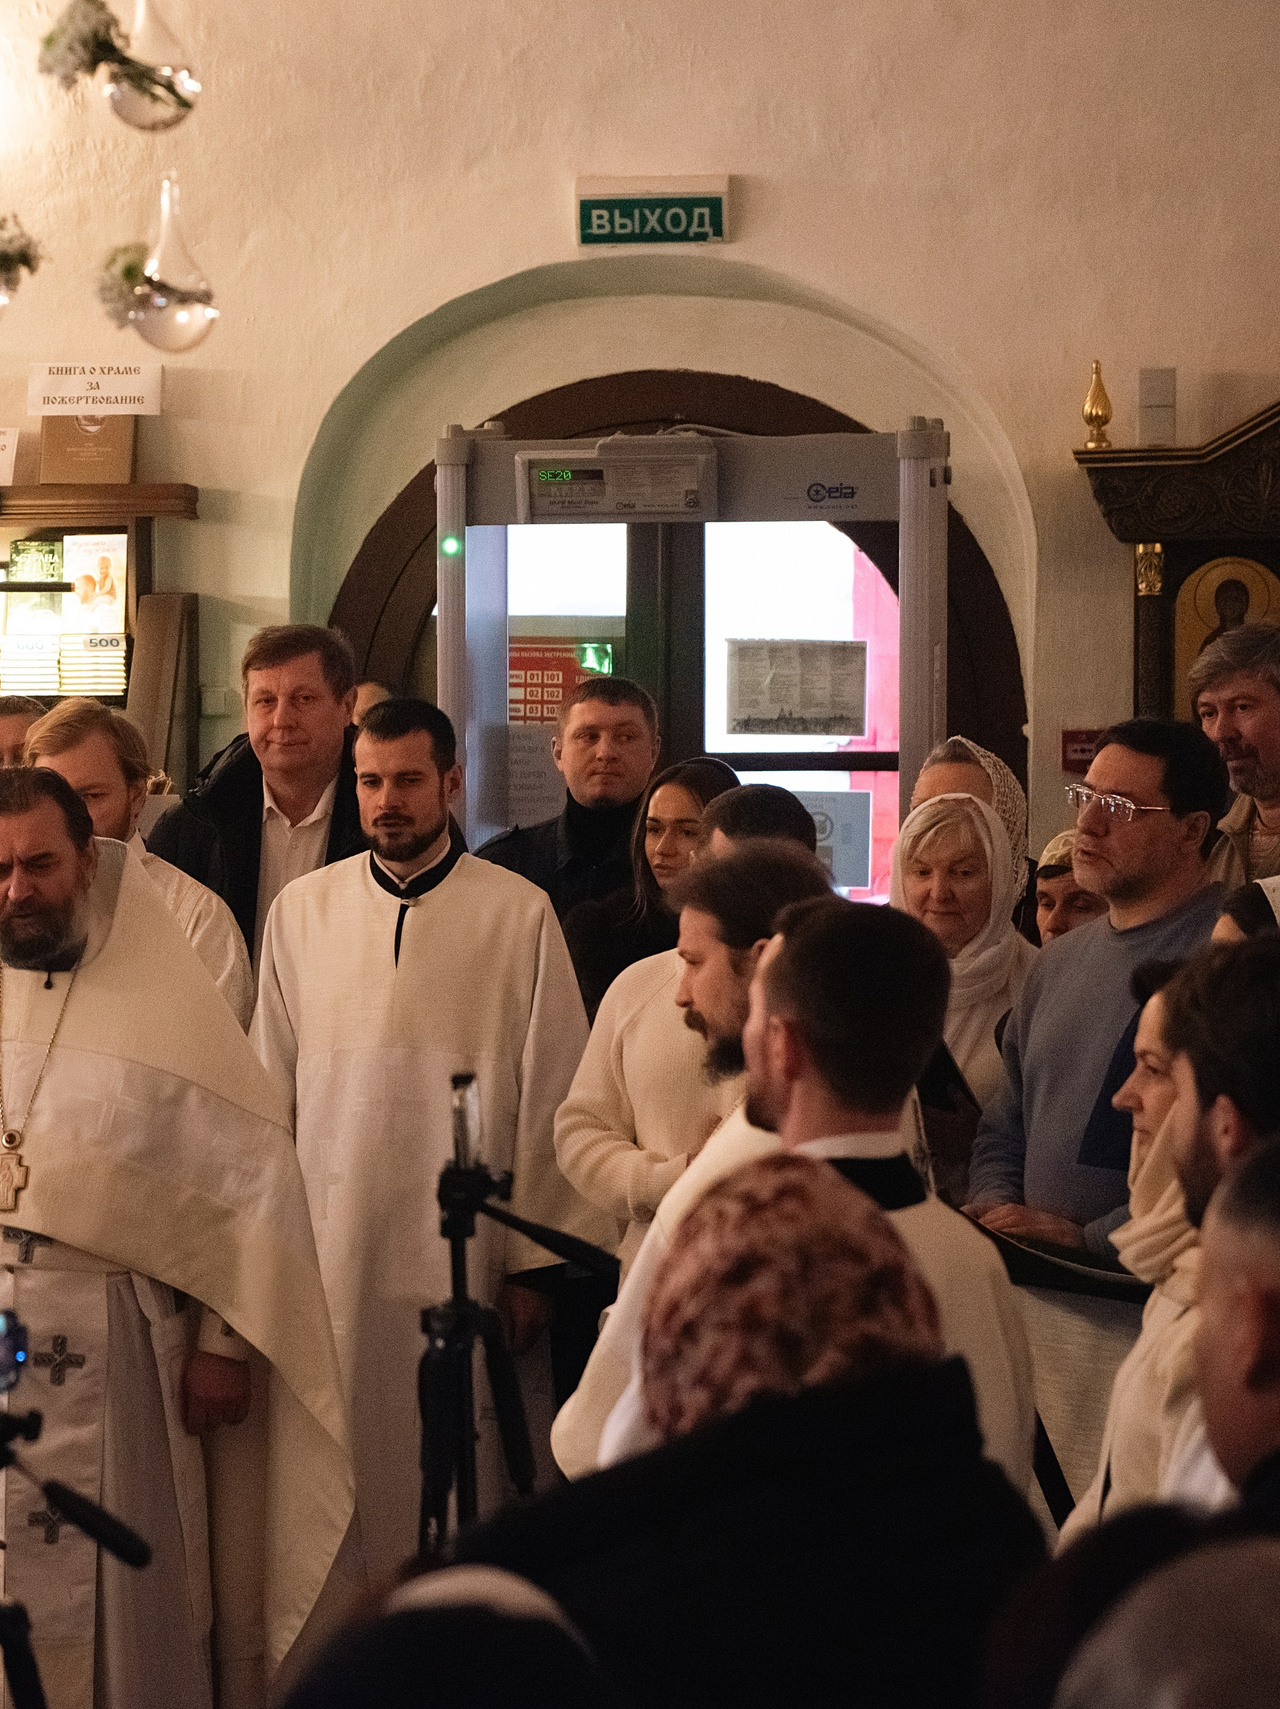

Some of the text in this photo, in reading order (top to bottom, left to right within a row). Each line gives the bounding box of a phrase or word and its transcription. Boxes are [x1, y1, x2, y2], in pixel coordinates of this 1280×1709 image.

[589, 206, 714, 239] ВЫХОД
[48, 366, 141, 376] КНИГА О ХРАМЕ
[86, 381, 100, 391] ЗА
[42, 395, 145, 405] ПОЖЕРТВОВАНИЕ
[538, 470, 572, 481] SE20
[89, 638, 120, 648] 500
[529, 673, 539, 681] 01
[546, 673, 560, 681] 101
[528, 689, 560, 698] 02 102
[528, 706, 539, 714] 03
